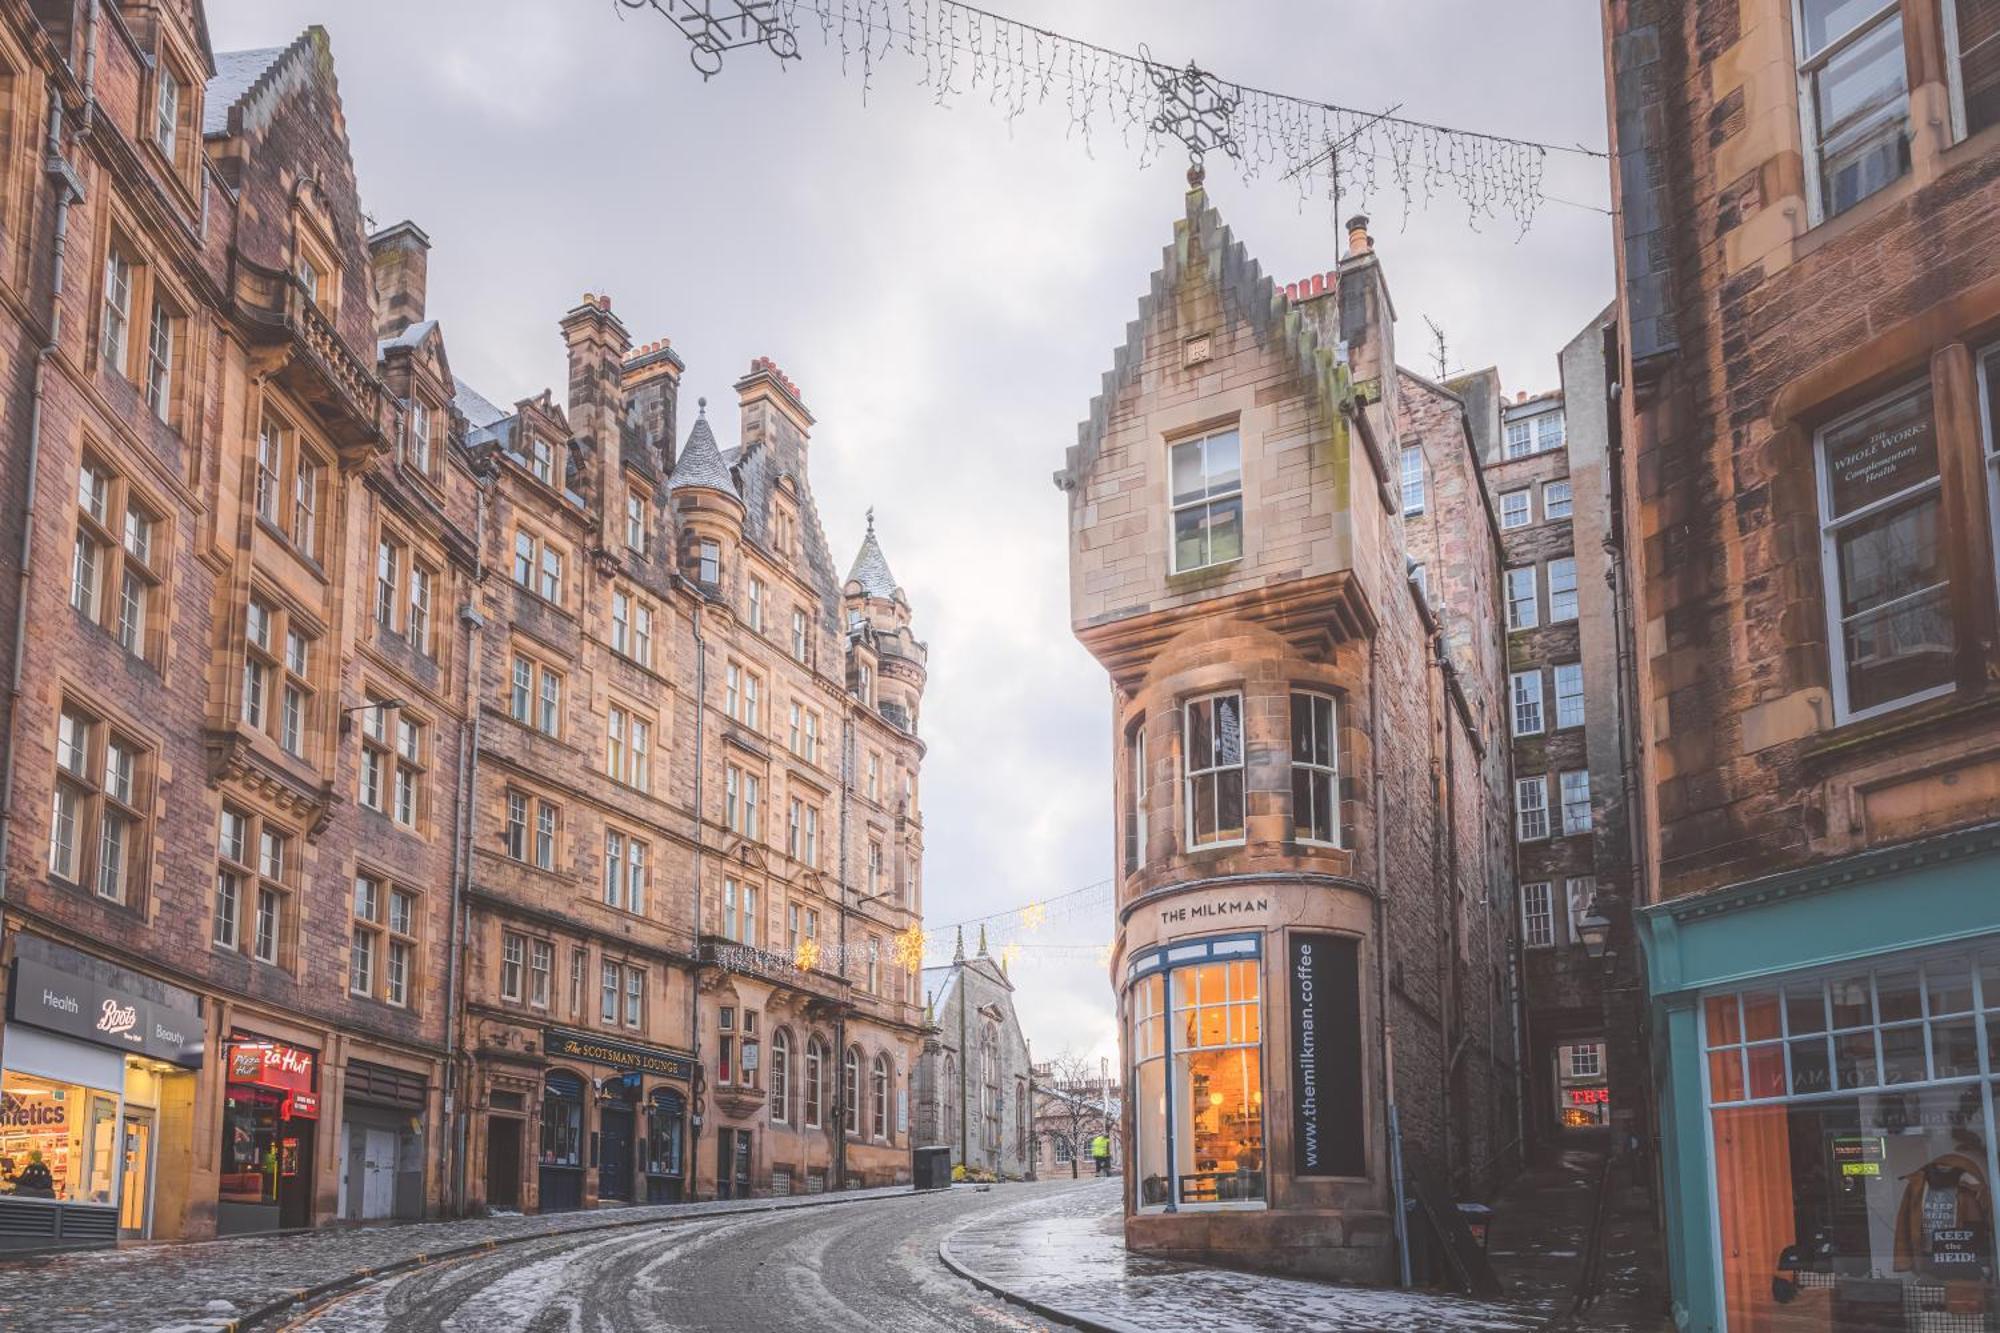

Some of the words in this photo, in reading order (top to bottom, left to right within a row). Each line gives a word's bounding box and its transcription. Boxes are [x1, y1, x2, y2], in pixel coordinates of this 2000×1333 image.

[1834, 444, 1878, 472] WHOLE
[1881, 424, 1928, 449] WORKS
[1844, 445, 1918, 481] Complementary
[1865, 463, 1898, 484] Health
[1160, 908, 1187, 925] THE
[1191, 898, 1269, 918] MILKMAN
[43, 989, 79, 1014] Health
[96, 998, 137, 1034] Boots
[156, 1024, 185, 1048] Beauty
[281, 1048, 312, 1075] Hut
[563, 1040, 581, 1055] The
[583, 1044, 641, 1065] SCOTSMAN'S
[643, 1056, 679, 1074] LOUNGE
[1298, 943, 1317, 1168] www.themilkman.coffee
[1934, 1231, 1974, 1242] KEEP
[1944, 1242, 1963, 1250] the
[1934, 1252, 1977, 1263] HEID!
